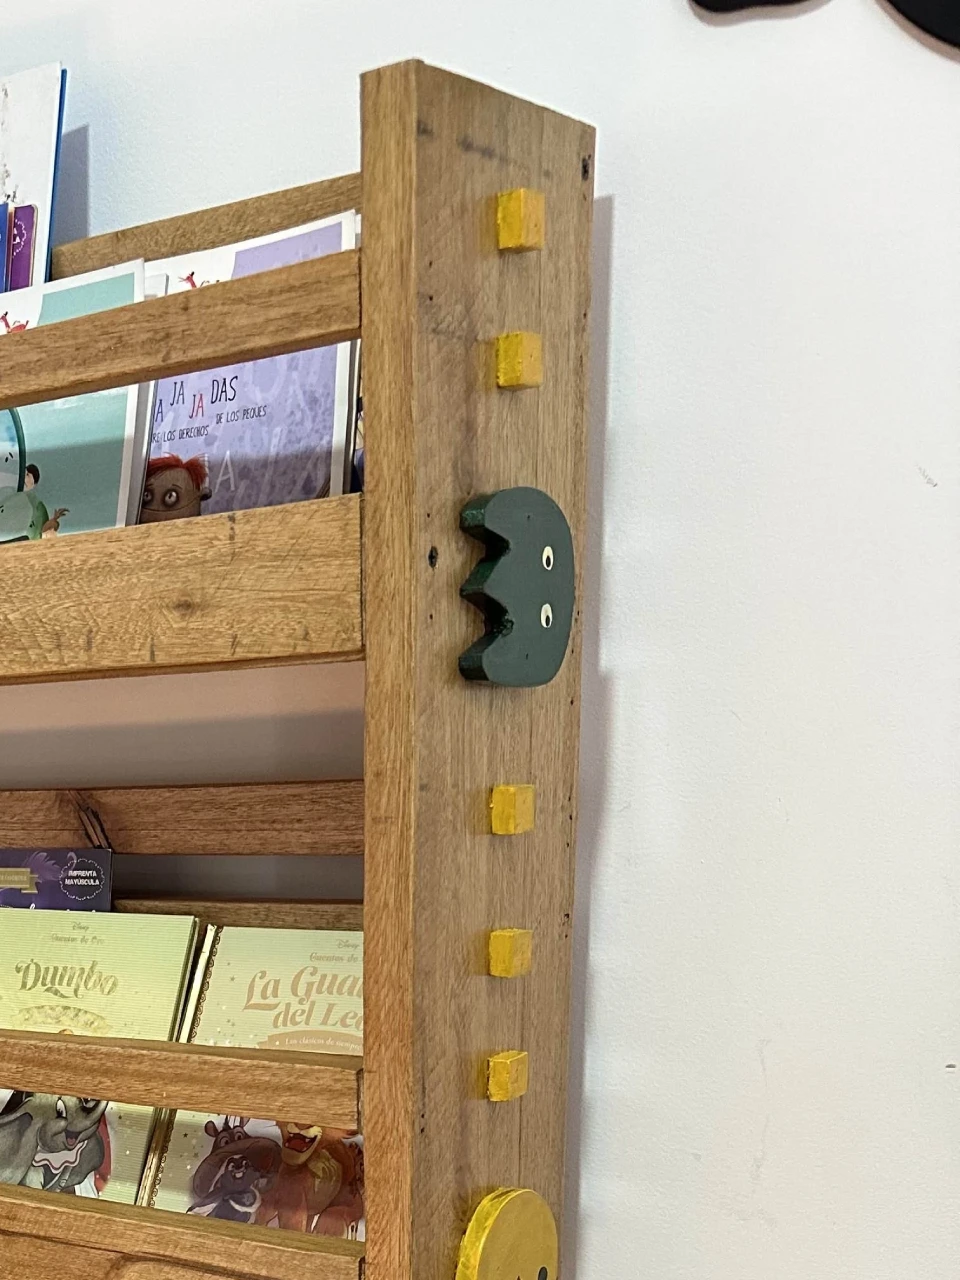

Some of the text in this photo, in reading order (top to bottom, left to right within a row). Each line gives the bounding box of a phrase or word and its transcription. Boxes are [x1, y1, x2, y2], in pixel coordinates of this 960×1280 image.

[210, 376, 238, 405] DAS
[226, 409, 240, 423] LOS
[242, 404, 268, 420] PEQUES
[163, 429, 176, 442] LOS
[179, 425, 210, 440] DERECHOS
[65, 877, 100, 886] MAYÚSCULA
[309, 951, 359, 963] Cuentos de
[14, 958, 119, 999] Dumbo
[242, 965, 364, 1012] La Gua
[271, 1000, 317, 1029] del
[326, 1037, 335, 1046] de
